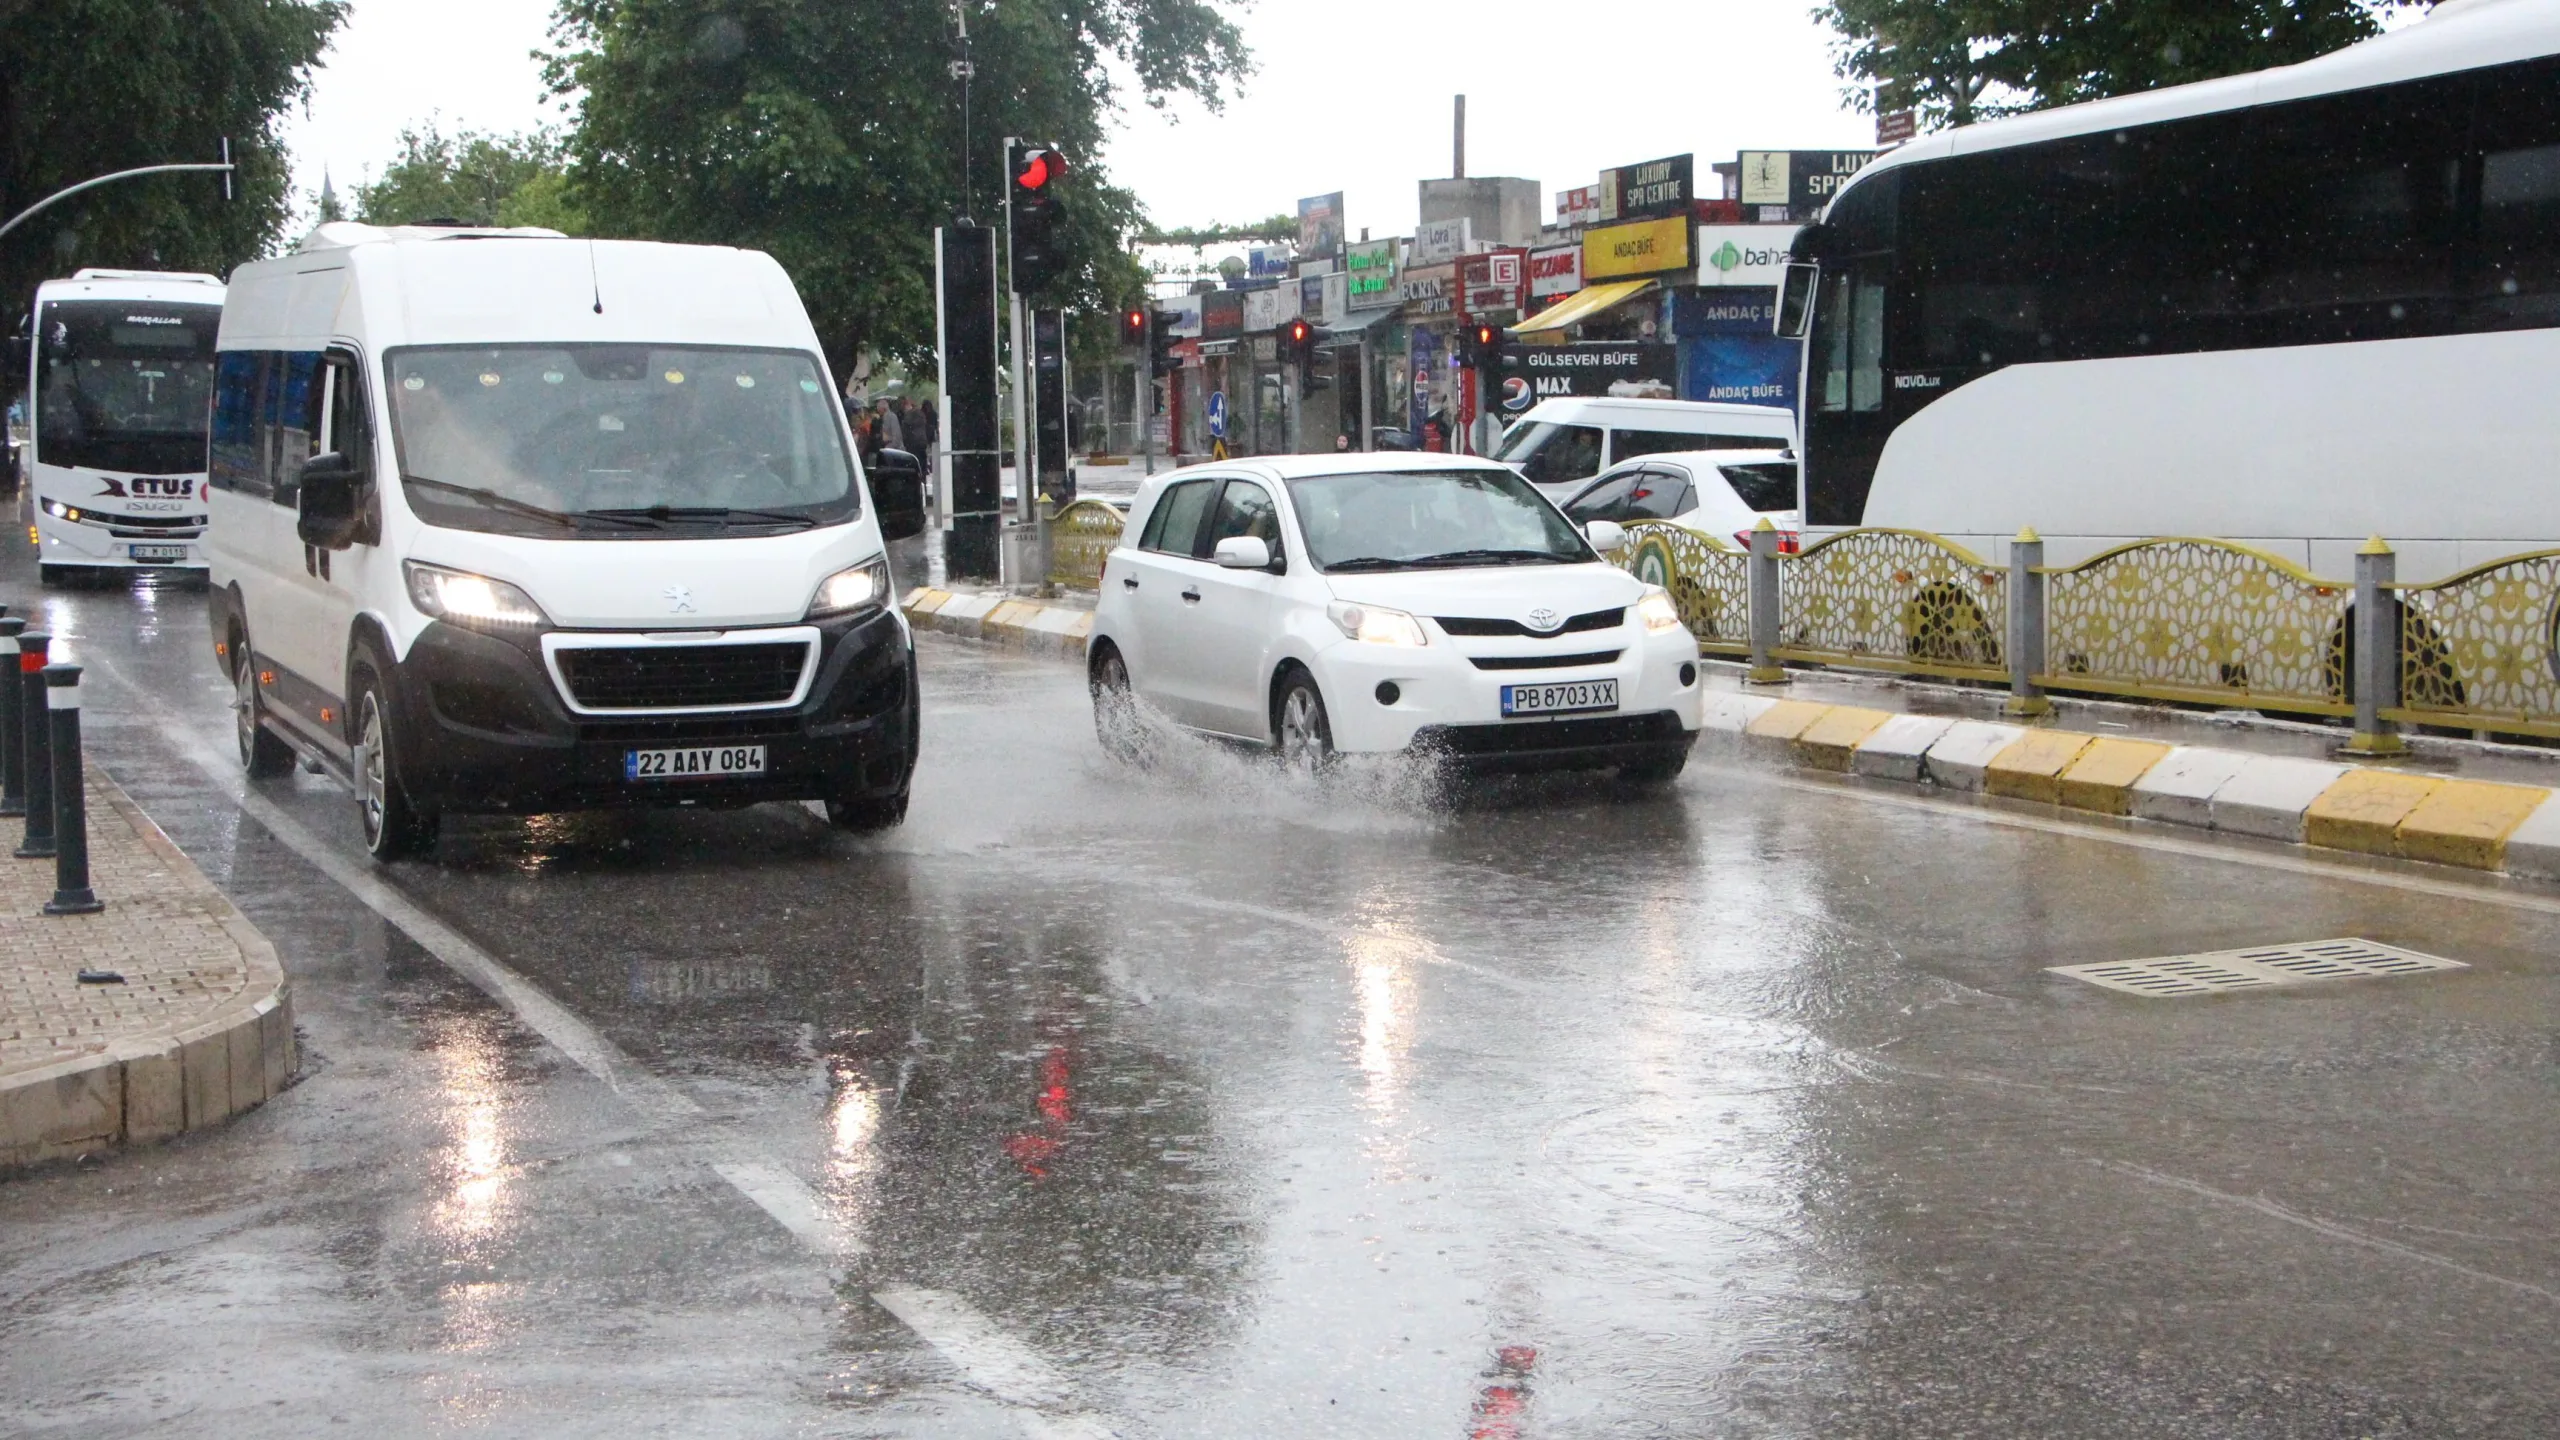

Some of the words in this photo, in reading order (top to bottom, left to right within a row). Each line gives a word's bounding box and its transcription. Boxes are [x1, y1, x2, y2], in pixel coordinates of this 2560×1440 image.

[1832, 154, 1877, 173] LUX
[1636, 162, 1671, 185] LUXURY
[1627, 185, 1645, 208] SPA
[1646, 180, 1681, 203] CENTRE
[1500, 264, 1511, 280] E
[1707, 306, 1760, 322] ANDAÇ
[1528, 352, 1600, 366] GÜLSEVEN
[1603, 351, 1638, 366] BÜFE
[1536, 376, 1572, 394] MAX
[1709, 385, 1749, 400] ANDAÇ
[1752, 383, 1784, 398] BÜFE
[131, 478, 193, 495] ETUS
[126, 501, 184, 511] ISUZU
[1515, 688, 1541, 709] PB
[1544, 686, 1588, 707] 8703
[1592, 683, 1613, 704] XX
[639, 753, 666, 775] 22
[673, 750, 713, 773] AAY
[720, 748, 762, 771] 084
